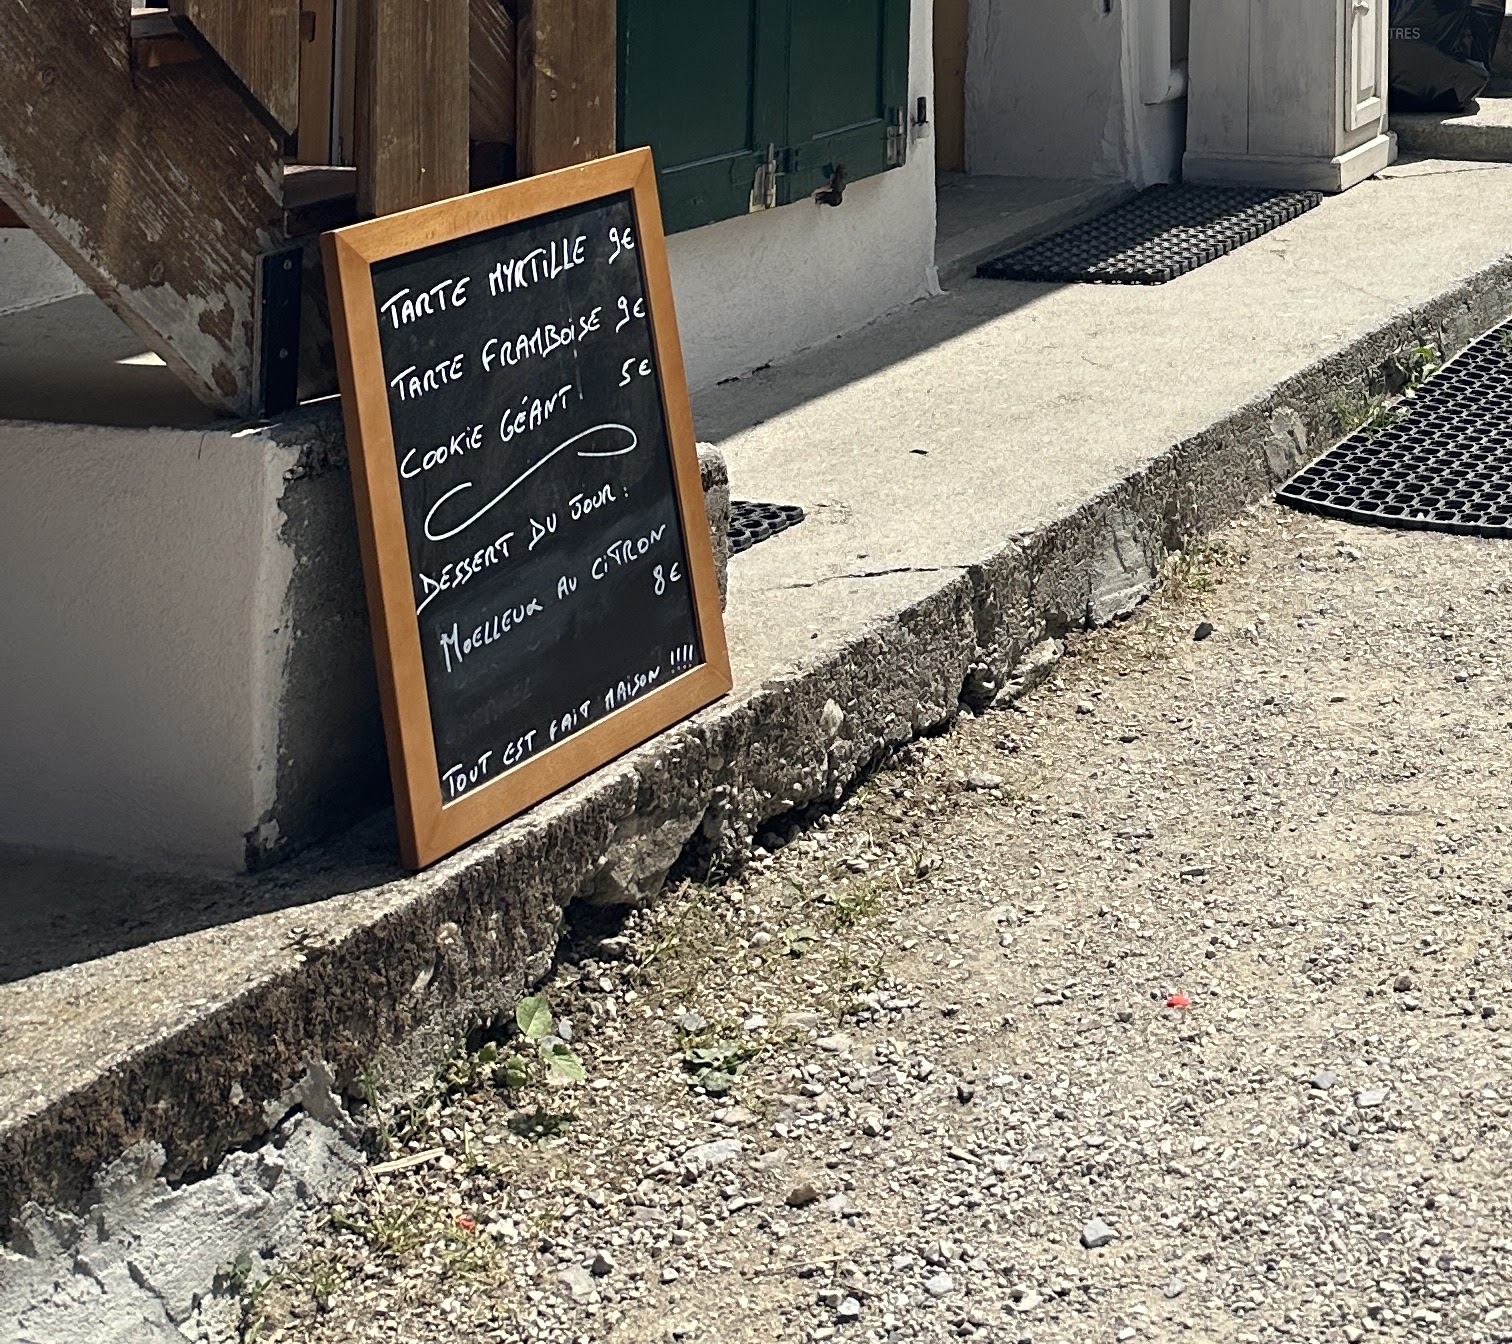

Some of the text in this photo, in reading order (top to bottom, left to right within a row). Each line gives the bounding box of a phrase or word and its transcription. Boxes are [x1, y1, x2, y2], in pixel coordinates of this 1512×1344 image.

[1389, 27, 1421, 40] TRES
[380, 276, 471, 329] TARTE
[390, 353, 464, 401] TARTE
[500, 384, 572, 442] GÉANT
[416, 531, 515, 616] DESSERT
[527, 512, 557, 551] DU
[557, 575, 578, 600] AU
[442, 750, 493, 798] TOUT
[502, 729, 537, 765] EST
